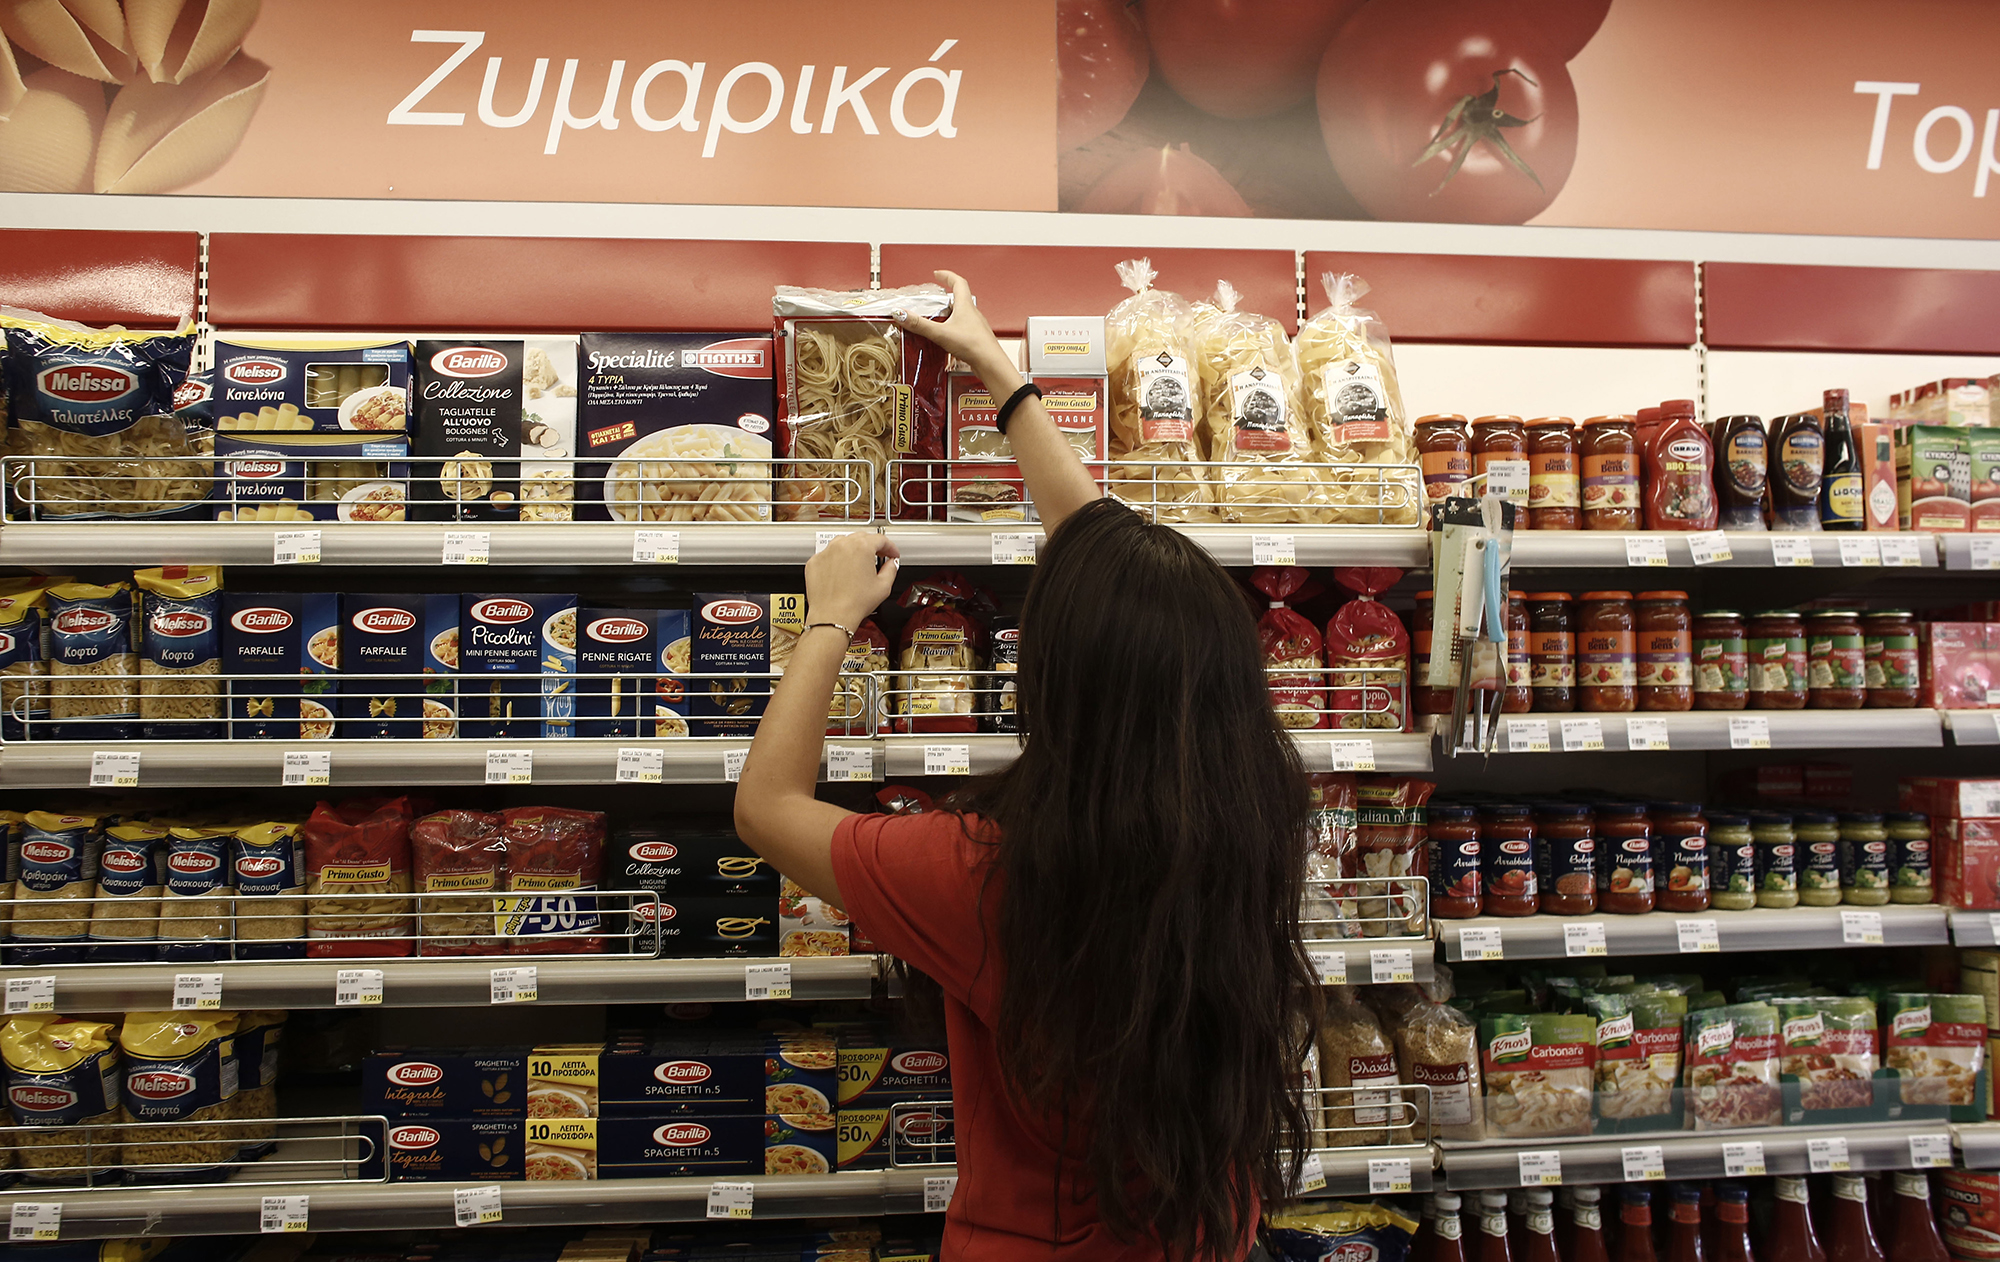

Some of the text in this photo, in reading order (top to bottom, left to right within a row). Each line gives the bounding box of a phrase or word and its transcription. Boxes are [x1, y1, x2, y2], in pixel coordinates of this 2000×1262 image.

[387, 29, 962, 158] Ζυμαρικά
[448, 353, 502, 370] Barilla
[587, 350, 675, 374] Specialité
[700, 353, 756, 364] ΓΙΩΤΗΣ
[234, 366, 280, 379] Melissa
[51, 372, 126, 392] Melissa
[588, 376, 624, 384] 4 ΤΥΡΙΑ
[226, 388, 285, 401] Κανελόνια
[422, 381, 513, 402] Collezione
[965, 398, 987, 406] Primo
[1046, 399, 1092, 408] Primo Gusto
[51, 408, 134, 425] Ταλιατέλλες
[439, 407, 496, 417] TAGLIATELLE
[898, 392, 909, 448] Primo Gusto
[446, 427, 488, 436] BOLOGNESI
[622, 423, 635, 432] 2
[592, 436, 608, 446] ΚΑΙ
[1666, 462, 1707, 472] BBQ Sauce
[778, 597, 796, 610] 10
[486, 605, 528, 617] Barilla
[716, 606, 758, 617] Barilla
[60, 613, 108, 628] Melissa
[159, 617, 204, 630] Melissa
[246, 614, 288, 626] Barilla
[368, 614, 411, 626] Barilla
[601, 624, 643, 635] Barilla
[472, 626, 533, 646] Piccolini
[699, 626, 767, 646] Integrale
[918, 632, 961, 641] Primo Gusto
[64, 645, 98, 660] Κοφτό
[239, 646, 284, 655] FARFALLE
[360, 647, 407, 655] FARFALLE
[922, 646, 955, 656] Ravioli
[1432, 619, 1448, 677] basic line
[162, 649, 195, 662] Κοφτό
[582, 653, 652, 661] PENNE RIGATE
[26, 846, 66, 857] Melissa
[640, 846, 674, 856] Barilla
[104, 855, 141, 867] Melissa
[172, 855, 212, 867] Melissa
[240, 860, 278, 872] Melissa
[22, 869, 68, 883] Κριθαράκι
[327, 868, 385, 880] Primo Gusto
[626, 863, 682, 878] Collezione
[102, 876, 145, 888] Κουσκουσέ
[168, 877, 214, 888] Κουσκουσέ
[239, 882, 281, 893] Κουσκουσέ
[432, 876, 489, 888] Primo Gusto
[518, 878, 575, 888] Primo Gusto
[498, 899, 507, 912] 2
[529, 896, 577, 931] -50
[362, 994, 382, 1002] 1,22€
[517, 992, 536, 1000] 1,94€
[202, 1000, 220, 1008] 1,04€
[1897, 1014, 1929, 1029] Knorr
[1600, 1023, 1632, 1039] Knorr
[1787, 1022, 1821, 1037] Knorr
[1948, 1028, 1954, 1036] 4
[1493, 1038, 1530, 1053] Knorr
[1701, 1032, 1732, 1047] Knorr
[838, 1053, 882, 1062] ΠΡΟΣΦΟΡΑ!
[1532, 1046, 1584, 1058] Carbonara
[474, 1060, 509, 1068] SPAGHETTI
[562, 1061, 586, 1069] ΛΕΠΤΑ
[904, 1056, 942, 1068] Barilla
[1350, 1059, 1389, 1074] Βλάχα
[400, 1068, 439, 1079] Barilla
[531, 1062, 551, 1076] 10
[553, 1068, 596, 1077] ΠΡΟΣΦΟΡΑ
[668, 1066, 707, 1077] Barilla
[1414, 1065, 1455, 1081] Βλάχα
[134, 1078, 186, 1092] Melissa
[882, 1076, 938, 1086] SPAGHETTI
[385, 1086, 446, 1102] Integrale
[646, 1085, 721, 1095] SPAGHETTI n.5
[16, 1092, 67, 1104] Melissa
[140, 1104, 180, 1117] Στριφτό
[23, 1116, 64, 1126] Στριφτό
[838, 1114, 884, 1123] ΠΡΟΣΦΟΡΑ!
[472, 1123, 506, 1131] SPAGHETTI
[530, 1125, 549, 1140] 10
[560, 1124, 585, 1132] ΛΕΠΤΑ
[397, 1132, 436, 1142] Barilla
[551, 1132, 594, 1141] ΠΡΟΣΦΟΡΑ
[666, 1128, 706, 1140] Barilla
[644, 1147, 720, 1157] SPAGHETTI n.5
[1308, 1179, 1325, 1189] 2,32€
[482, 1211, 500, 1220] 1,14€
[39, 1230, 58, 1238] 1,02€
